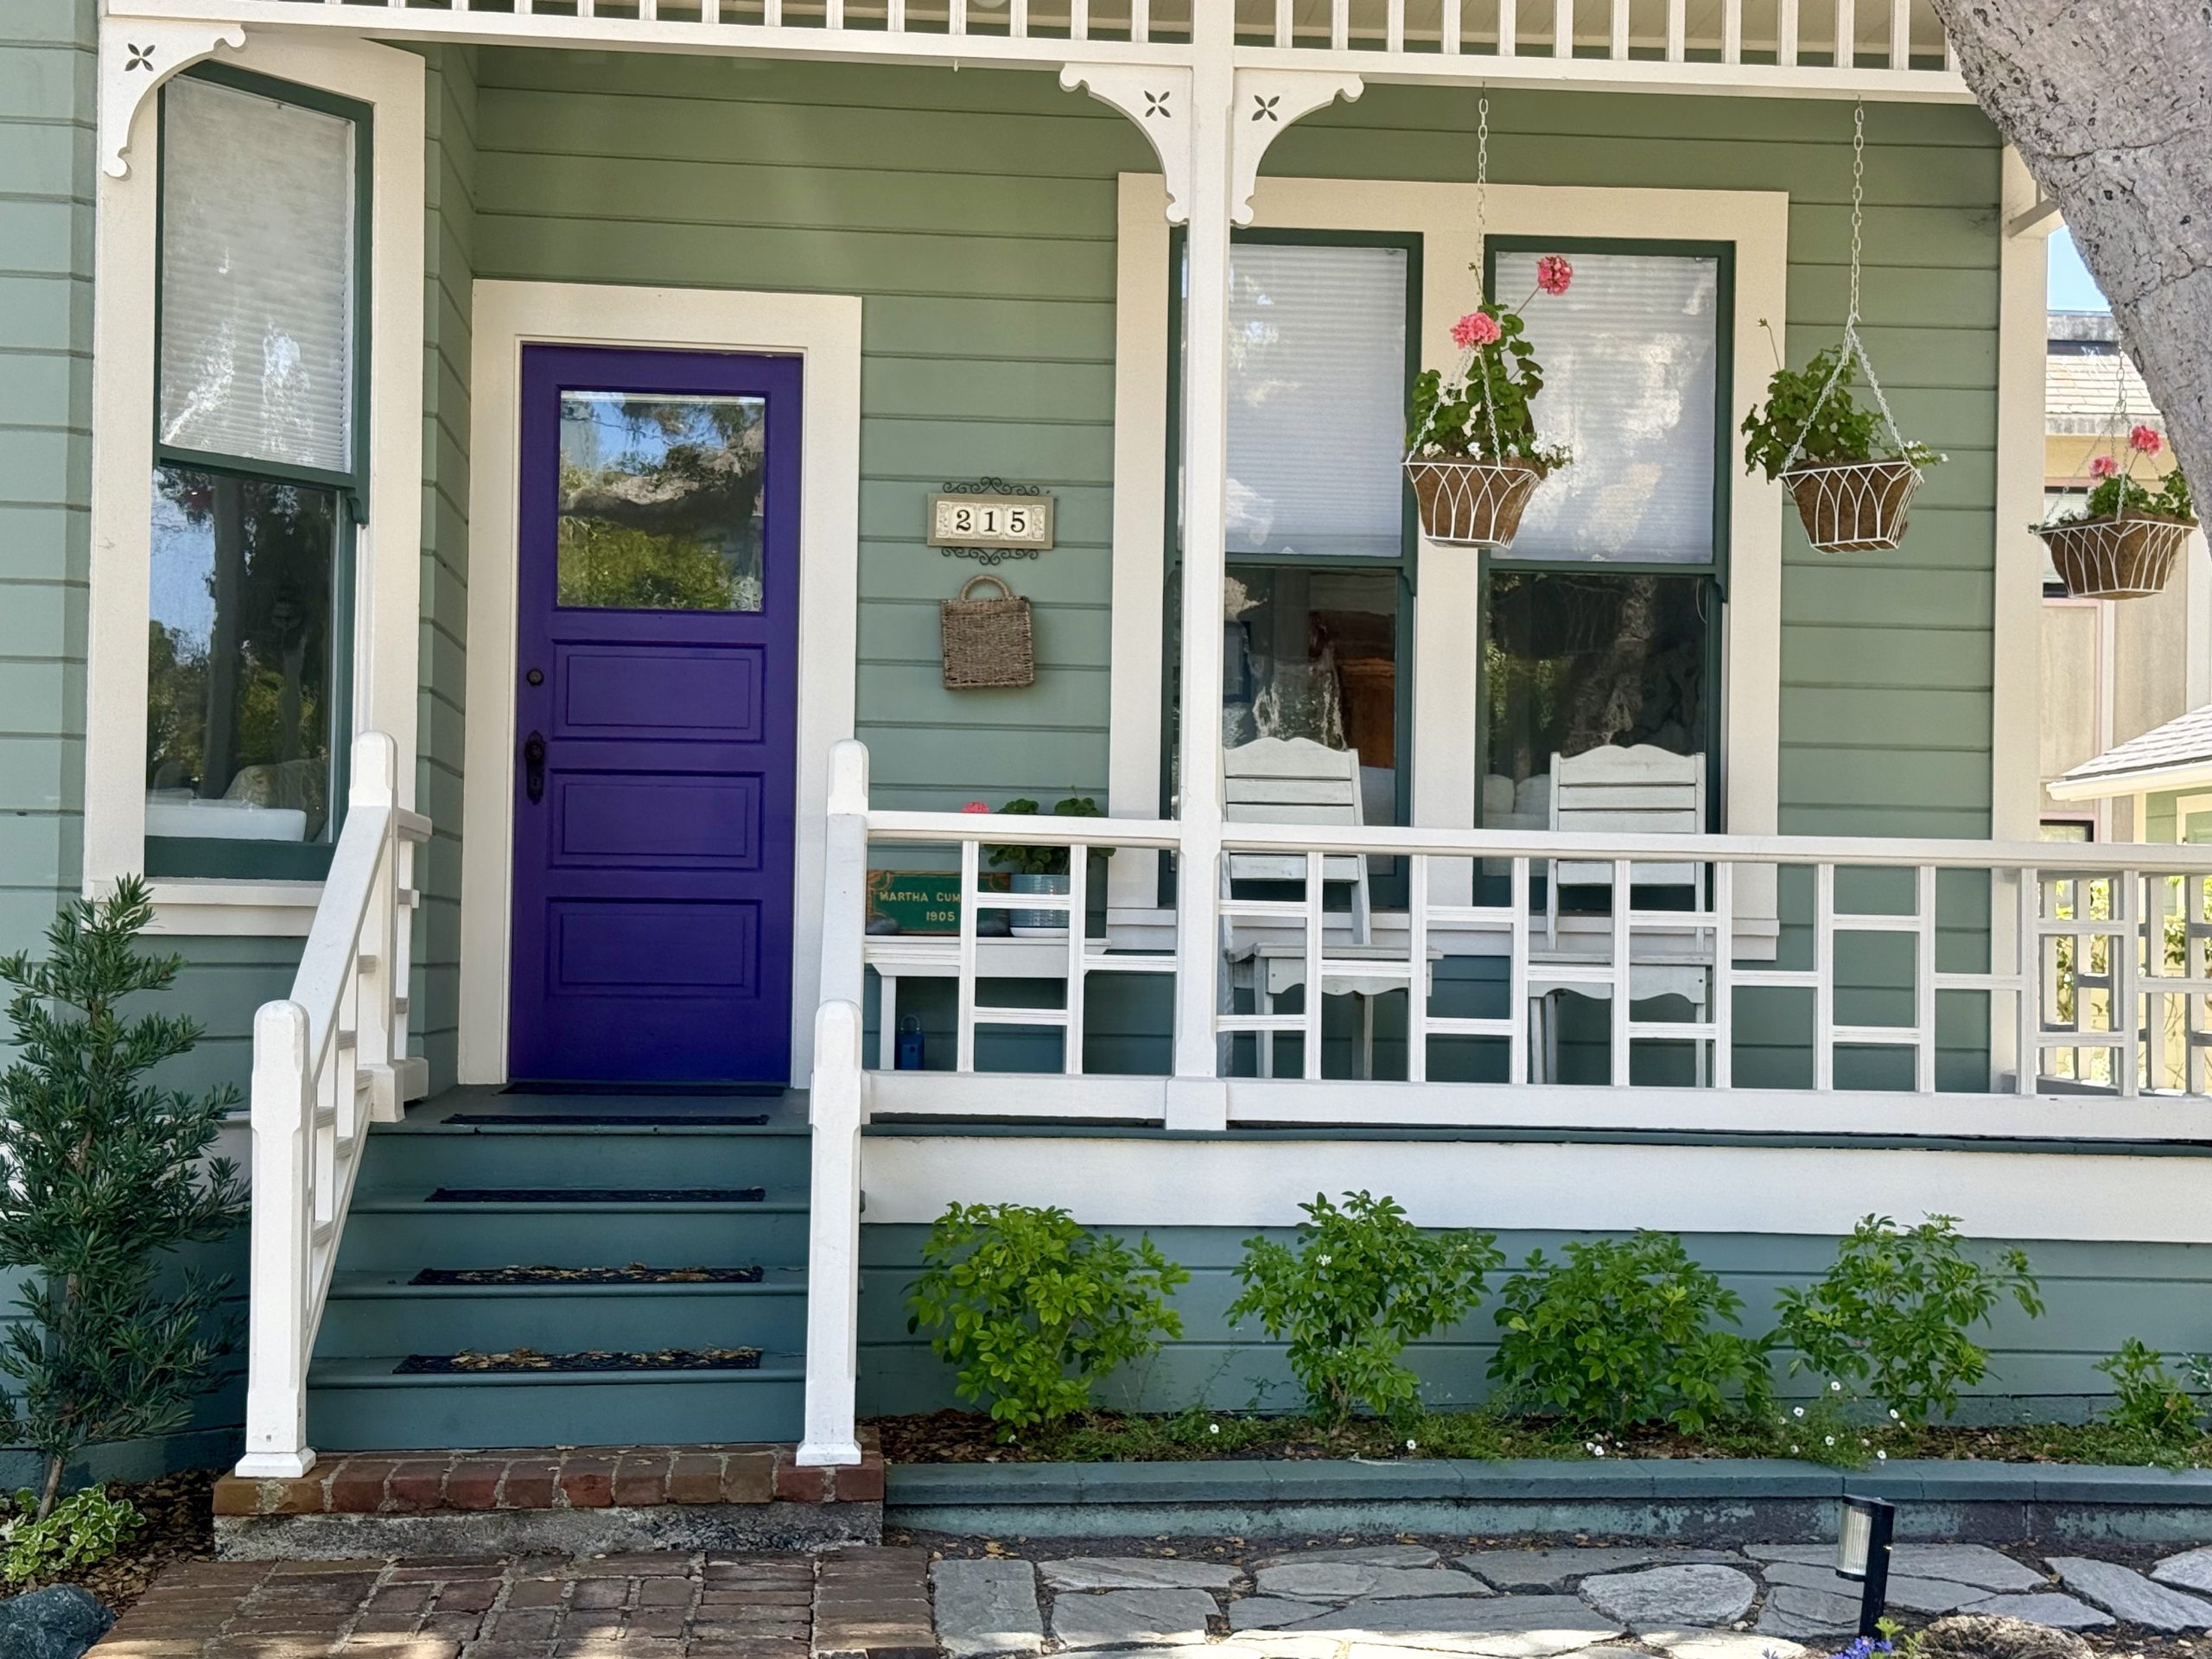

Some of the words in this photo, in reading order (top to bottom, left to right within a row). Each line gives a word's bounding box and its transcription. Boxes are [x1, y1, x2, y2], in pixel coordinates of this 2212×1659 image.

[956, 509, 1027, 533] 215
[880, 891, 929, 902] MARTHA
[936, 892, 961, 903] CUM
[925, 911, 956, 922] 1905
